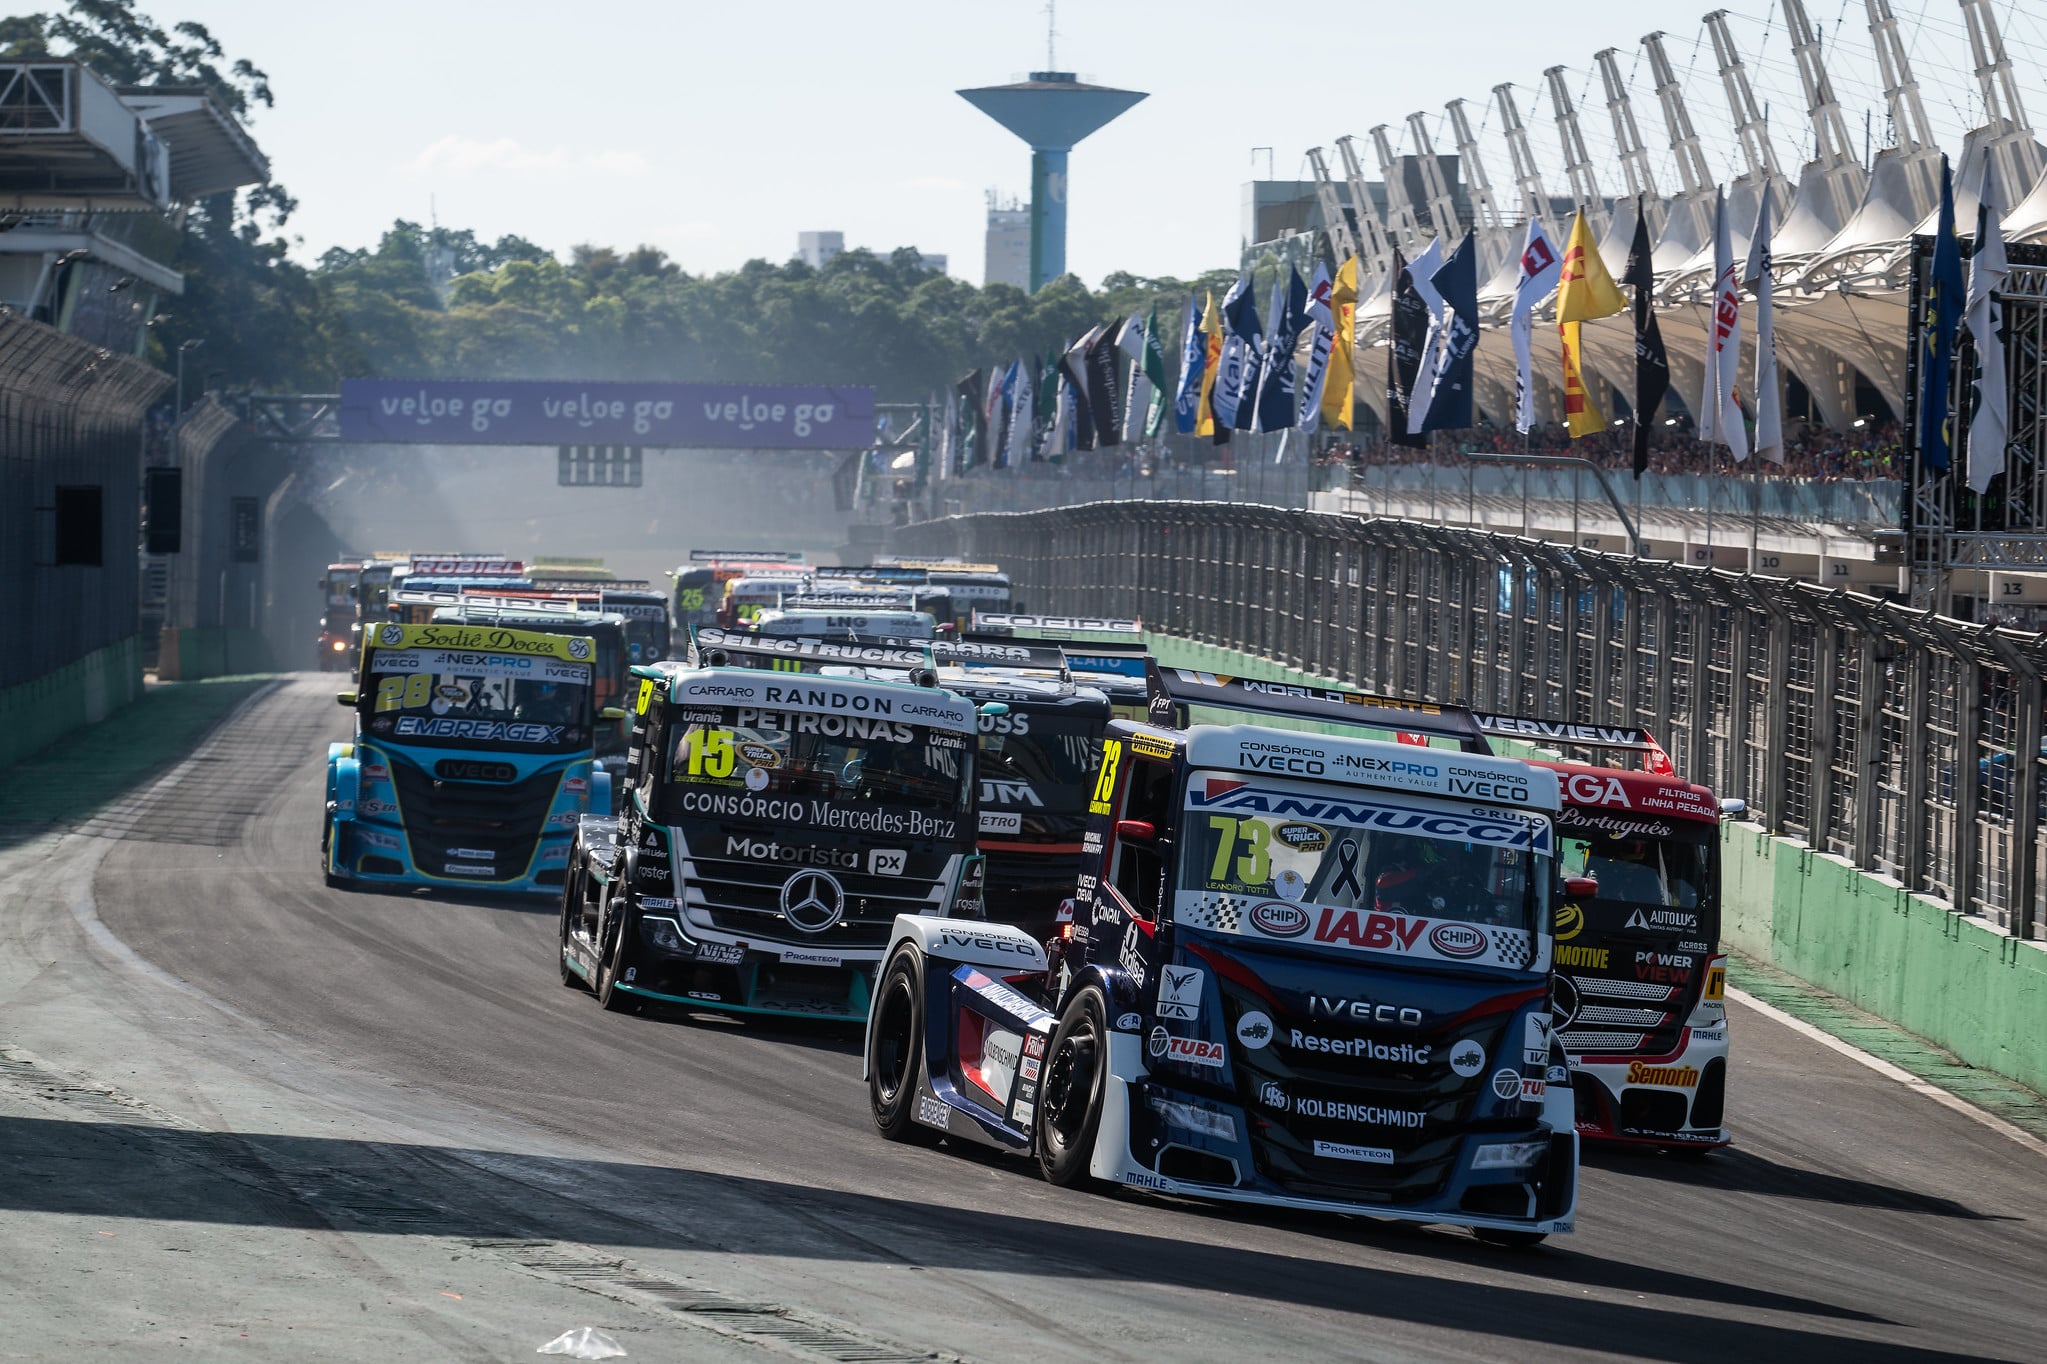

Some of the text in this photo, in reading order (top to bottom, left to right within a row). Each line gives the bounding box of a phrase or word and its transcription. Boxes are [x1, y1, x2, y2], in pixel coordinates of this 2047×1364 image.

[381, 390, 512, 432] veloe go
[543, 392, 673, 436] veloe go
[703, 395, 834, 437] veloe go
[414, 561, 522, 575] ROBIEL
[1761, 557, 1780, 568] 10
[1832, 564, 1849, 575] 11
[2003, 582, 2022, 596] 13
[682, 589, 704, 610] 25
[826, 616, 868, 629] LNG
[414, 626, 554, 654] Sodiê Doces
[374, 659, 419, 668] IVECO
[447, 653, 532, 668] NEXPRO
[545, 668, 589, 680] IVECO
[374, 673, 433, 713] 28
[688, 685, 755, 698] CARRARO
[766, 686, 892, 715] RANDON
[1243, 681, 1440, 715] WORLDPARTS
[901, 703, 964, 722] CARRARO
[1156, 698, 1171, 710] FPT
[683, 711, 722, 724] Urania
[738, 707, 914, 745] PETRONAS
[395, 716, 565, 744] EMBREAGEX
[684, 729, 735, 778] 15
[746, 751, 773, 760] TRUCK
[1239, 742, 1325, 758] CONSÓRCIO
[755, 760, 775, 768] PRO
[1092, 739, 1121, 802] 73
[1239, 752, 1325, 776] IVECO
[1346, 756, 1439, 778] NEXPRO
[1345, 770, 1439, 788] AUTHENTIC VALUE
[1448, 766, 1528, 785] CONSÓRCIO
[1448, 778, 1529, 802] IVECO
[1658, 787, 1701, 801] FILTROS
[683, 793, 956, 840] CONSÓRCIO Mercedes-Benz
[1471, 807, 1546, 826] GRUPO
[1641, 797, 1716, 819] LINHA PESADA
[1190, 789, 1552, 852] VANNUCCI
[1555, 806, 1674, 840] Português
[1282, 826, 1326, 852] SUPER TRUCK PRO
[726, 836, 859, 869] Motorista
[1209, 815, 1271, 885] 73
[875, 851, 901, 872] px
[1078, 873, 1097, 890] IVECO
[1205, 881, 1269, 895] LEANDRO TOTTI
[641, 898, 674, 910] MAHLE
[1076, 887, 1093, 903] DEVA
[1260, 908, 1299, 923] CHIPI
[942, 934, 1036, 957] IVECO
[1440, 930, 1477, 945] CHIPI
[1678, 941, 1708, 950] ACROSS
[783, 951, 840, 963] PROMETEON
[1554, 945, 1610, 969] MOTIVE
[1635, 951, 1693, 968] POWER
[1635, 964, 1691, 984] VIEW
[1308, 996, 1422, 1026] IVECO
[1693, 1030, 1722, 1041] MAHLE
[1169, 1038, 1223, 1060] TUBA
[1626, 1060, 1699, 1088] Semorin
[1297, 1098, 1427, 1128] KOLBENSCHMIDT
[1318, 1142, 1392, 1160] PROMETEON
[1126, 1171, 1167, 1190] MAHLE
